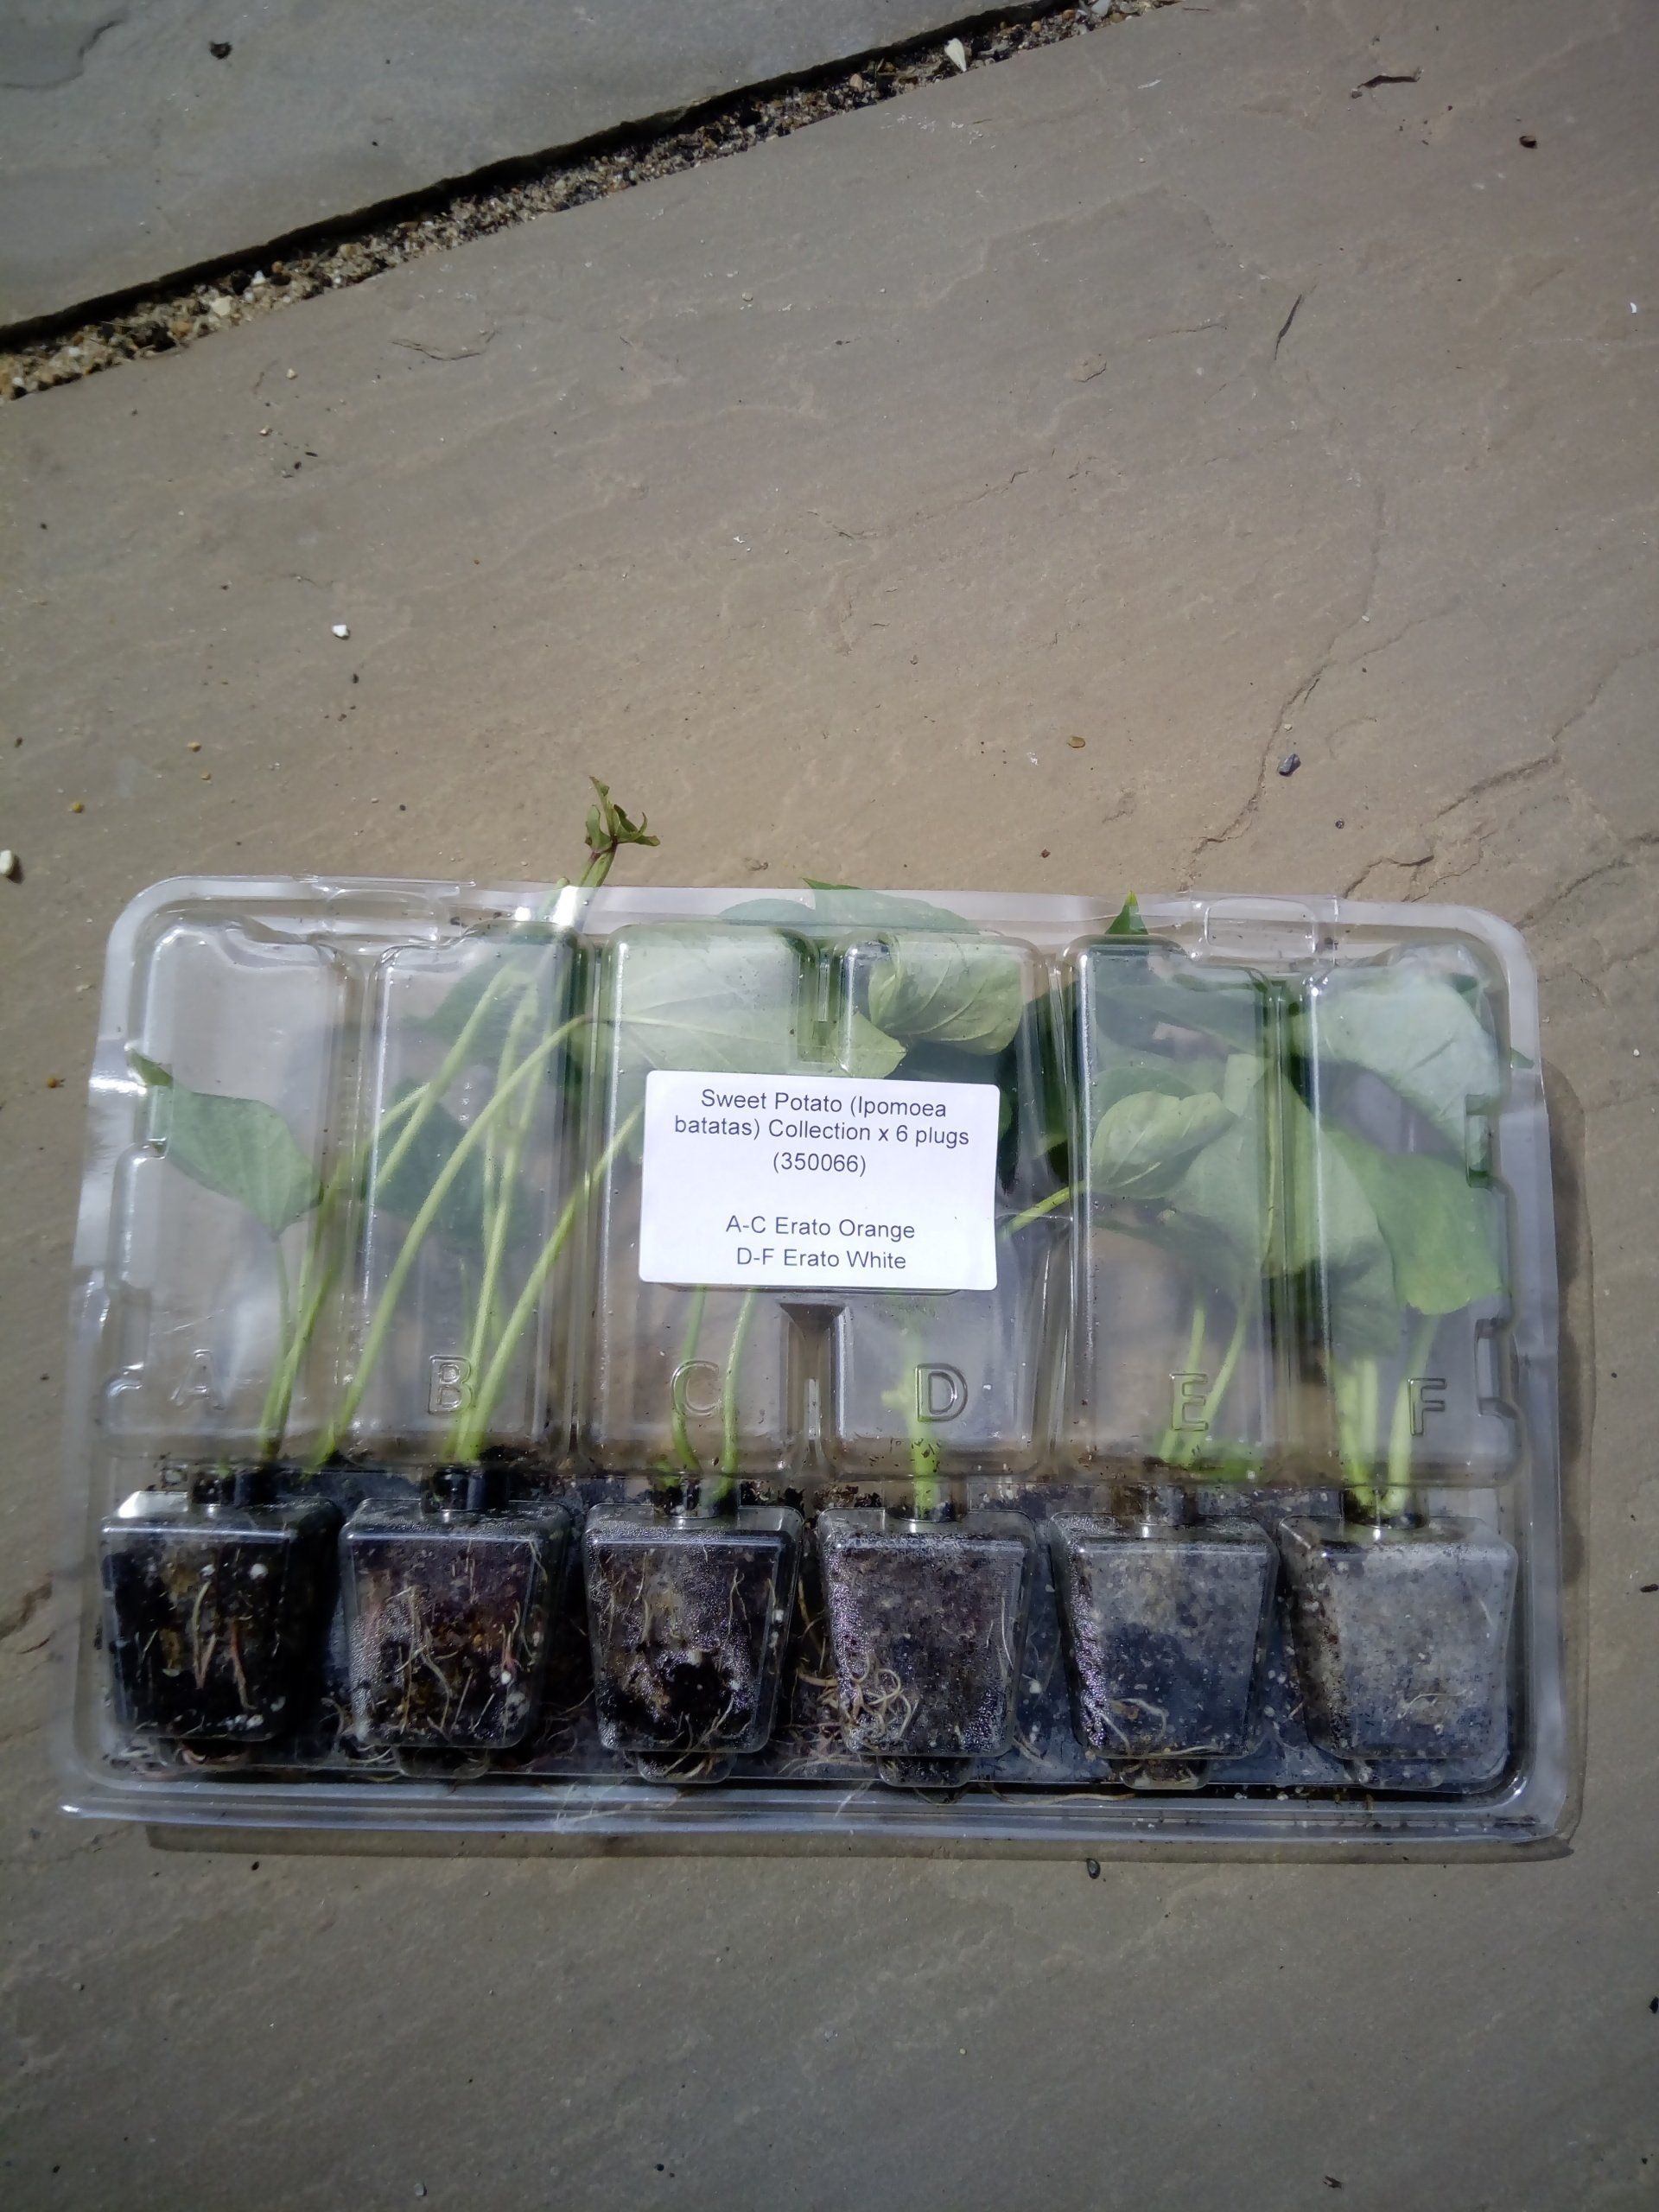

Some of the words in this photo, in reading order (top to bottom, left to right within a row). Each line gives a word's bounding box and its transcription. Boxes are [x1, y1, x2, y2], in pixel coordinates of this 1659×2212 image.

[701, 1089, 767, 1109] Sweet
[775, 1092, 842, 1113] Potato
[850, 1096, 946, 1118] (Ipomoea
[675, 1115, 760, 1141] batatas)
[768, 1118, 870, 1141] Collection
[878, 1128, 889, 1141] x
[896, 1124, 908, 1142] 6
[915, 1126, 969, 1149] plugs
[773, 1152, 866, 1178] (350066)
[725, 1215, 766, 1234] A-C
[775, 1217, 831, 1236] Erato
[839, 1218, 915, 1243] Orange
[737, 1247, 775, 1265] D-F
[784, 1249, 840, 1268] Erato
[846, 1250, 906, 1269] White
[428, 1354, 473, 1414] B
[671, 1359, 721, 1417] C
[915, 1363, 968, 1422] D
[1169, 1371, 1209, 1432] E
[1407, 1377, 1446, 1436] F
